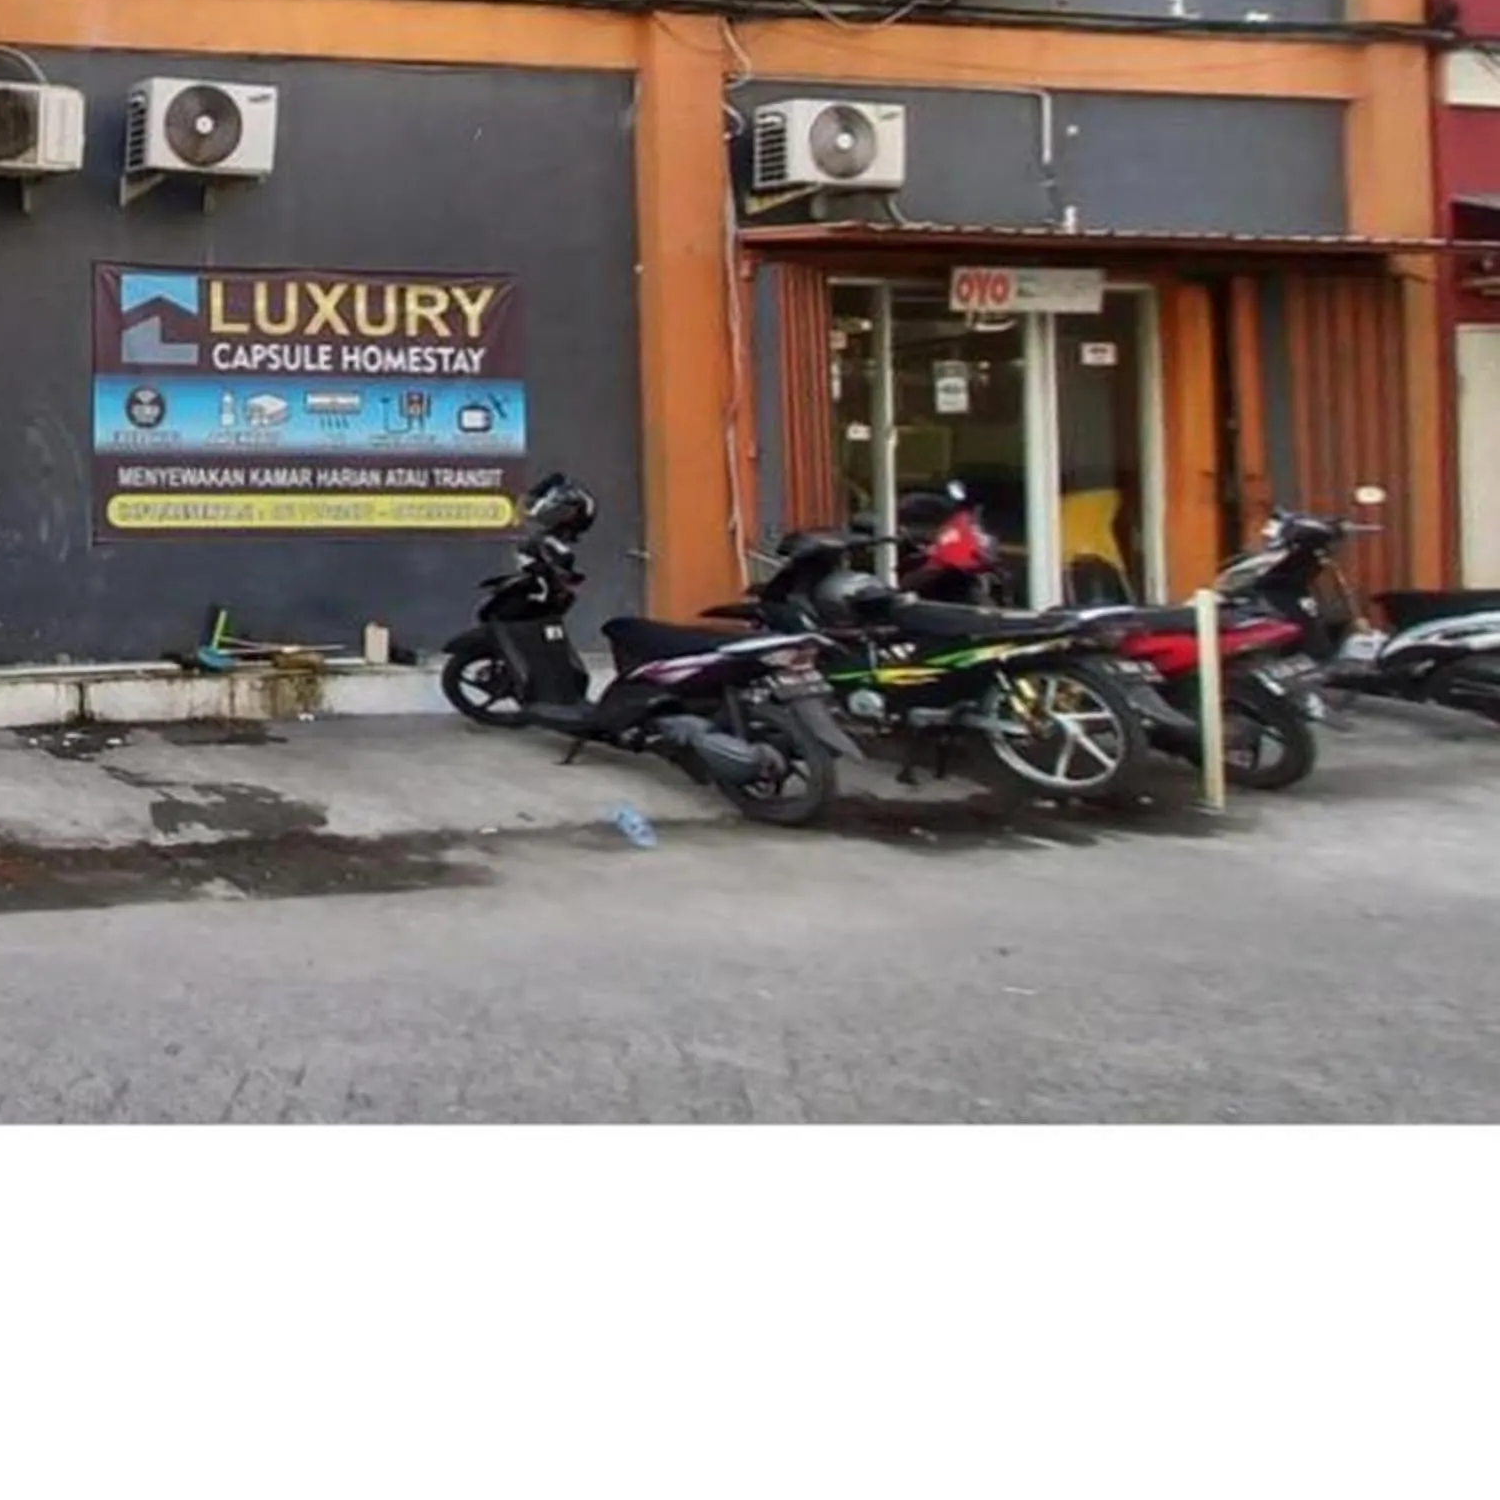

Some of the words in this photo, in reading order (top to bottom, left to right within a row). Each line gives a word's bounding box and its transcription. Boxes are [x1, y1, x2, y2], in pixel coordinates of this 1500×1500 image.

[956, 272, 1011, 306] OYO
[209, 280, 495, 338] LUXURY
[212, 343, 334, 372] CAPSULE
[341, 346, 486, 374] HOMESTAY
[117, 466, 245, 487] MENYEWAKAN
[250, 467, 313, 488] KAMAR
[385, 467, 430, 488] ATAU
[432, 468, 504, 488] TRANSIT
